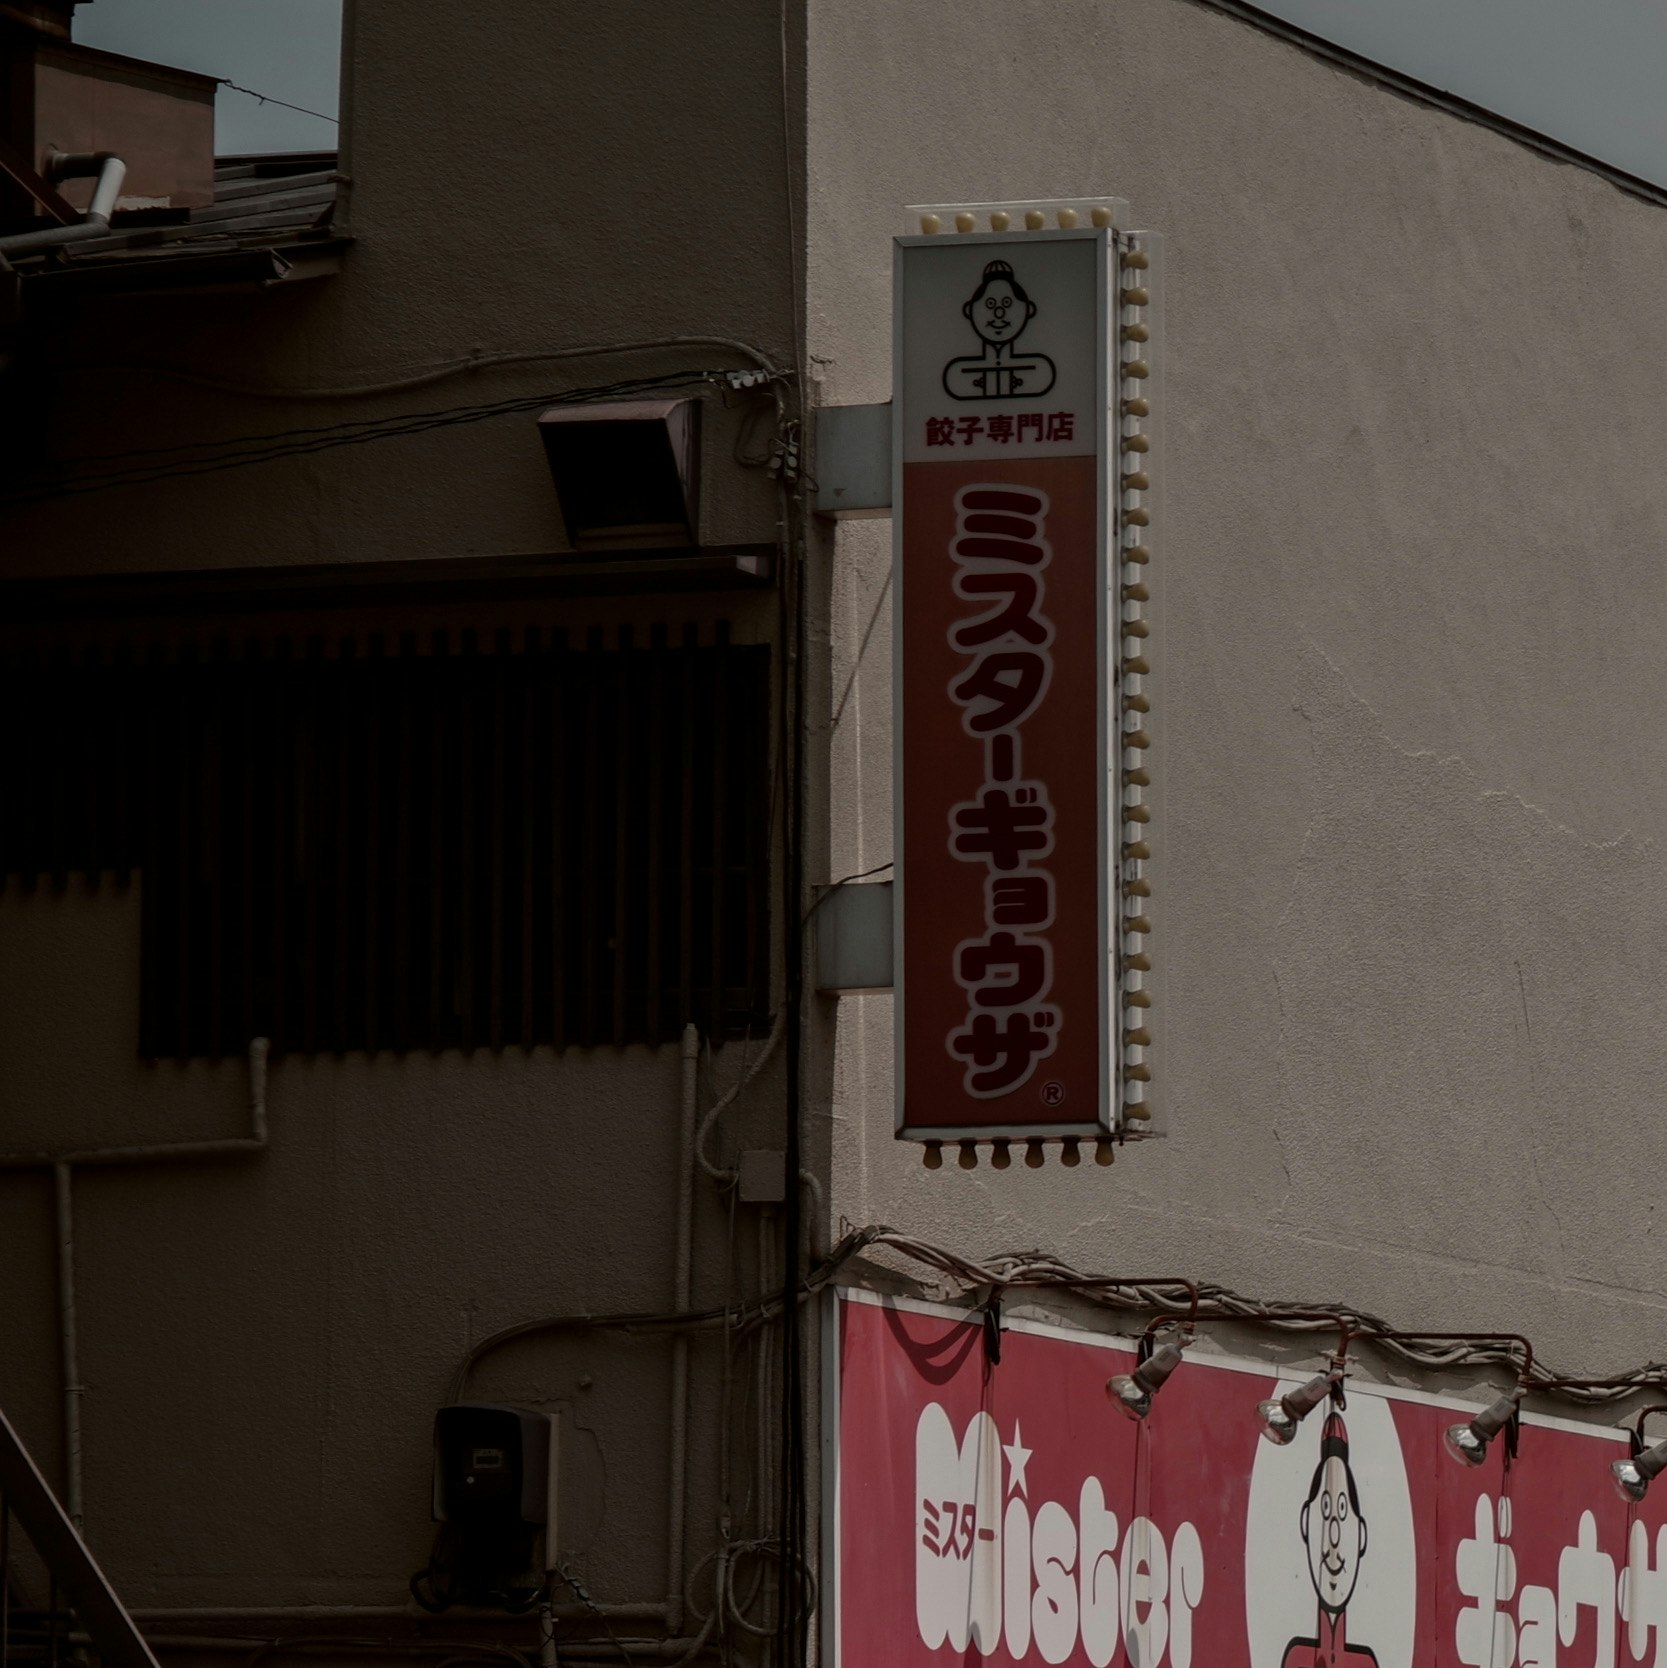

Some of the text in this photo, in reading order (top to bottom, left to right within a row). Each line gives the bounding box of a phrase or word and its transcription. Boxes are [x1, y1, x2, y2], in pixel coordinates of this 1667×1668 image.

[926, 411, 1076, 446] 餃子専門店
[949, 484, 1056, 1101] ミスターギョウザ
[921, 1497, 996, 1562] ミスター
